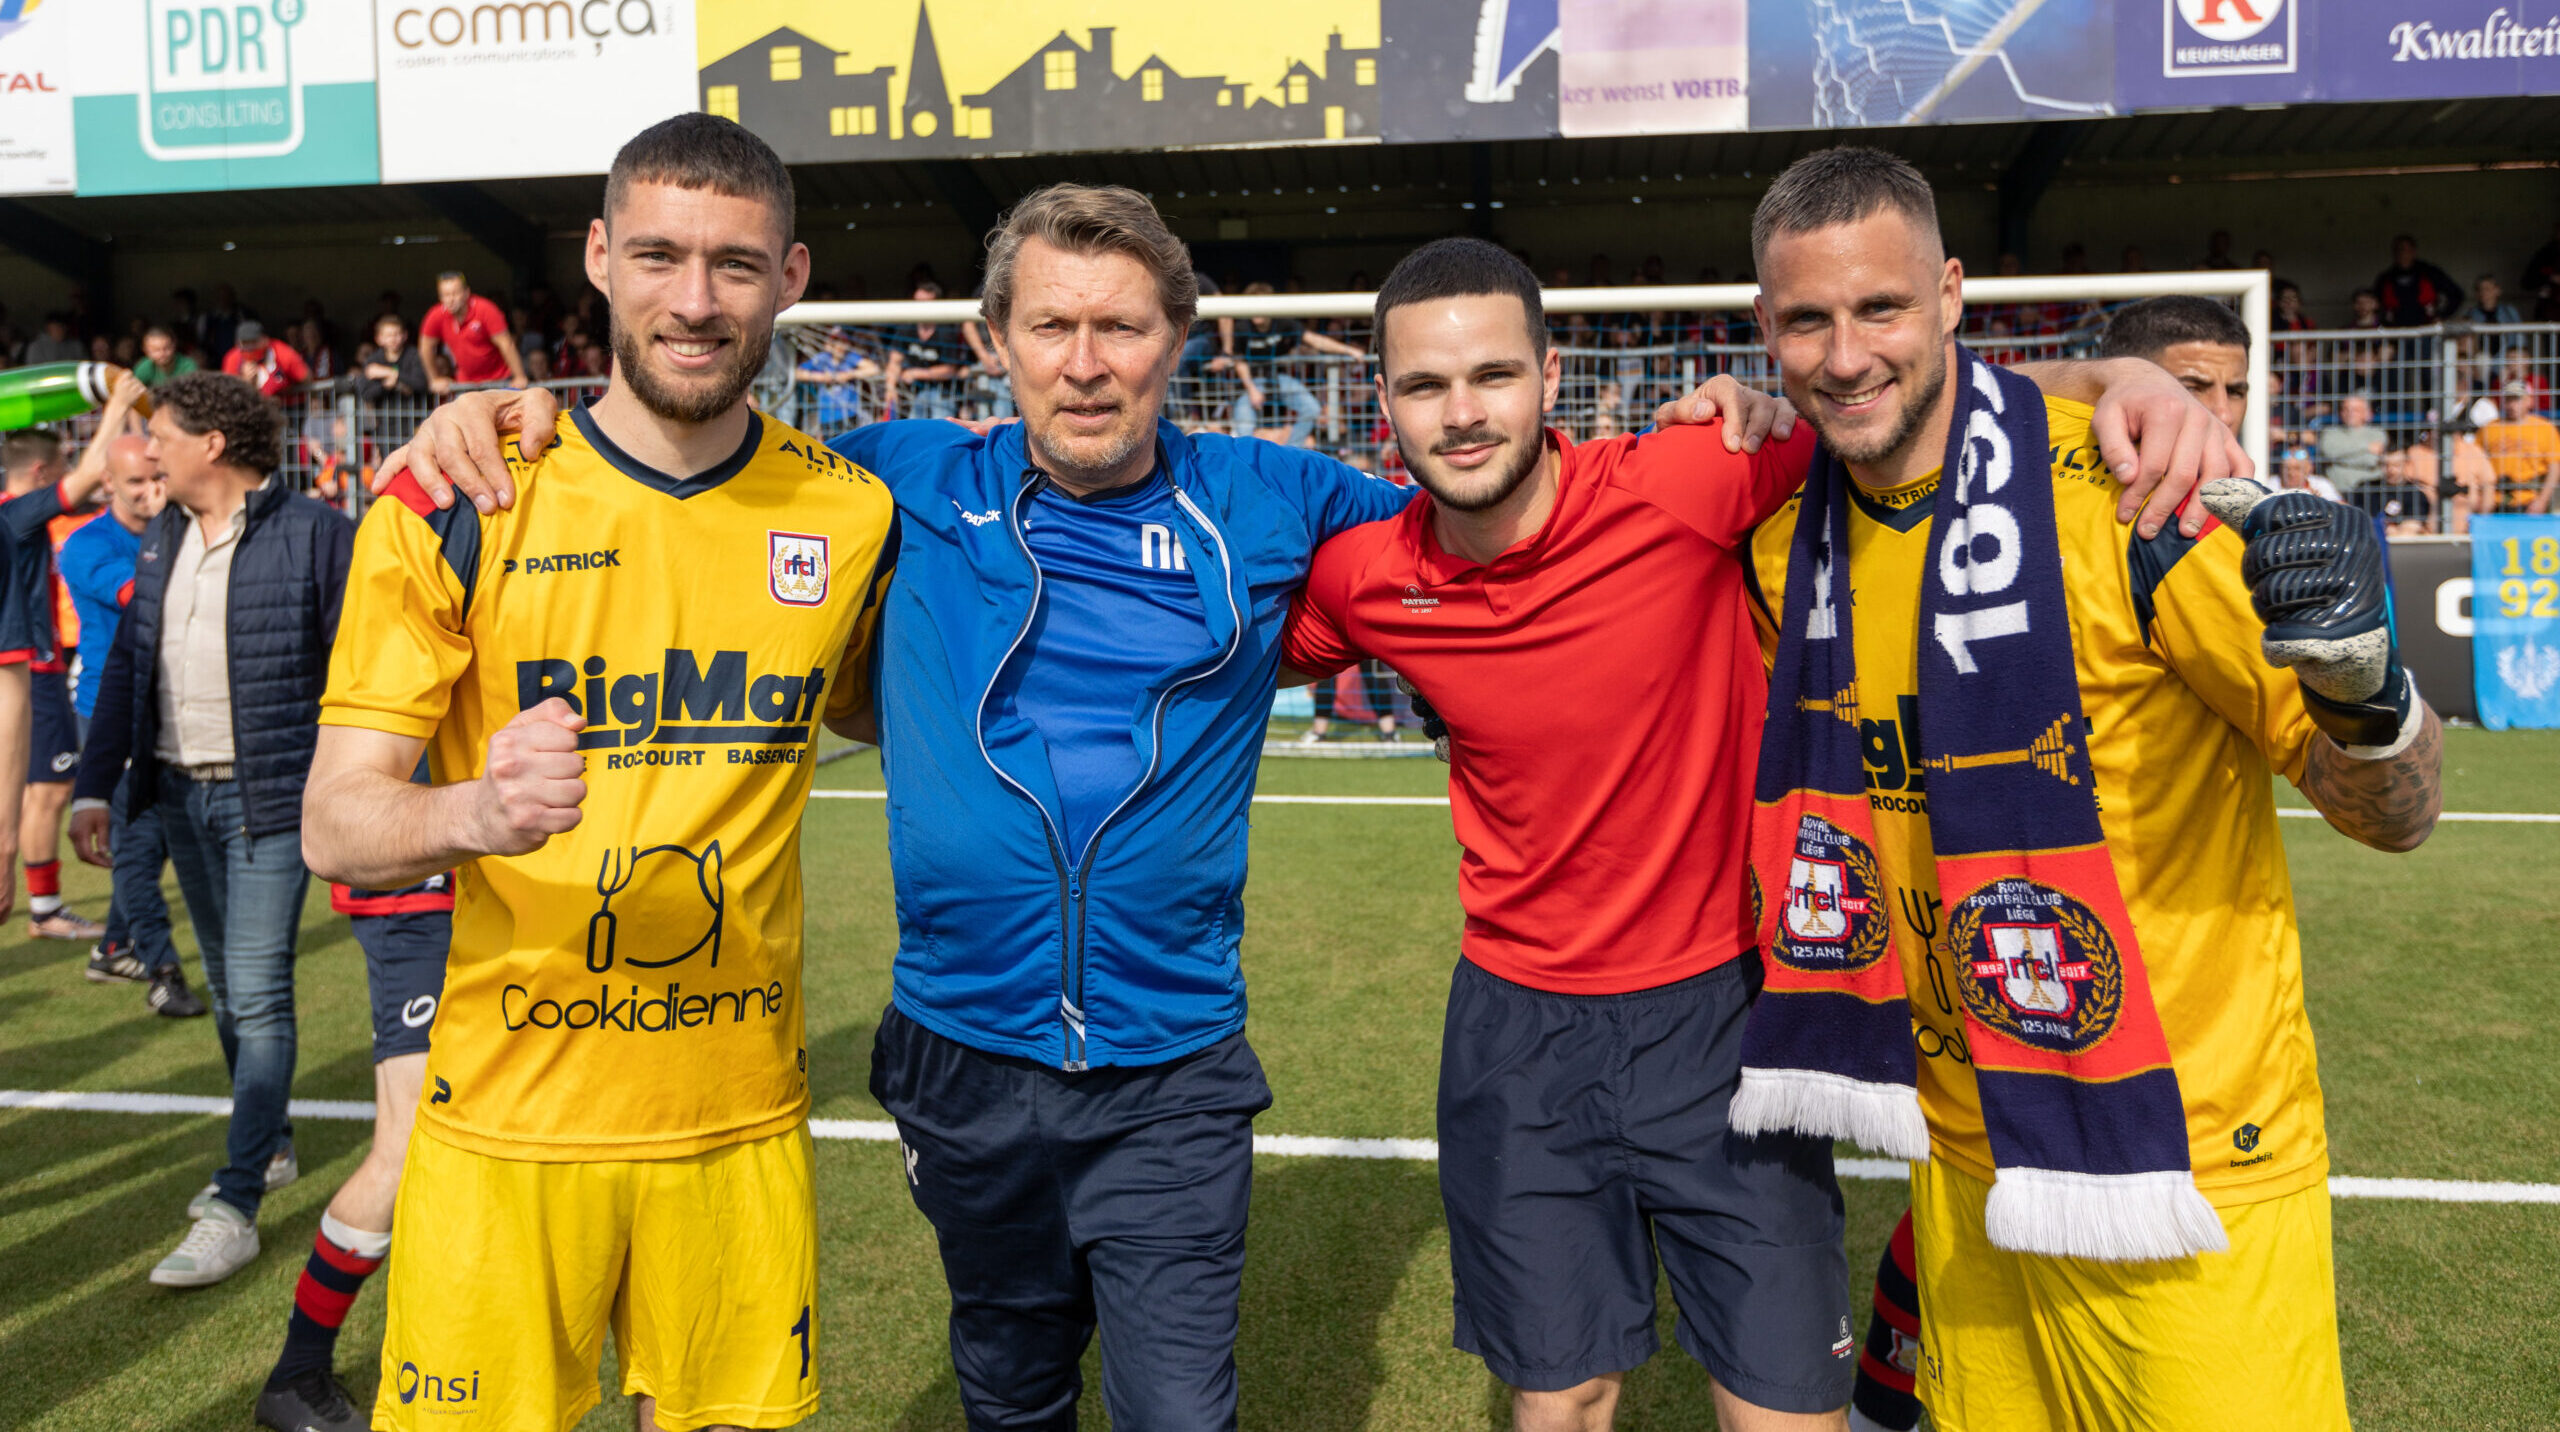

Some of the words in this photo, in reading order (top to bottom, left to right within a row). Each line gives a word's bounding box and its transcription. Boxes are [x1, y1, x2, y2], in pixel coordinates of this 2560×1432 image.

[166, 6, 266, 76] PDR
[1673, 78, 1741, 99] VOETB
[157, 100, 284, 129] CONSULTING
[1879, 480, 1941, 505] PATRIC
[526, 549, 621, 574] PATRICK
[784, 554, 815, 577] rfcl
[2502, 537, 2560, 576] 18
[2499, 578, 2560, 618] 92
[516, 648, 825, 747] BigMat
[607, 749, 706, 769] ROCOURT
[1802, 816, 1830, 833] ROYAL
[1823, 832, 1851, 846] CLUB
[1841, 899, 1866, 911] 2017
[1969, 892, 2032, 907] FOOTBALL
[1791, 945, 1814, 957] 125
[1815, 947, 1845, 959] ANS
[1976, 963, 2006, 975] 1892
[2059, 965, 2087, 978] 2017
[502, 980, 783, 1032] Cookidienne
[2020, 1019, 2044, 1033] 125
[2045, 1020, 2075, 1040] ANS
[790, 1304, 810, 1381] 1
